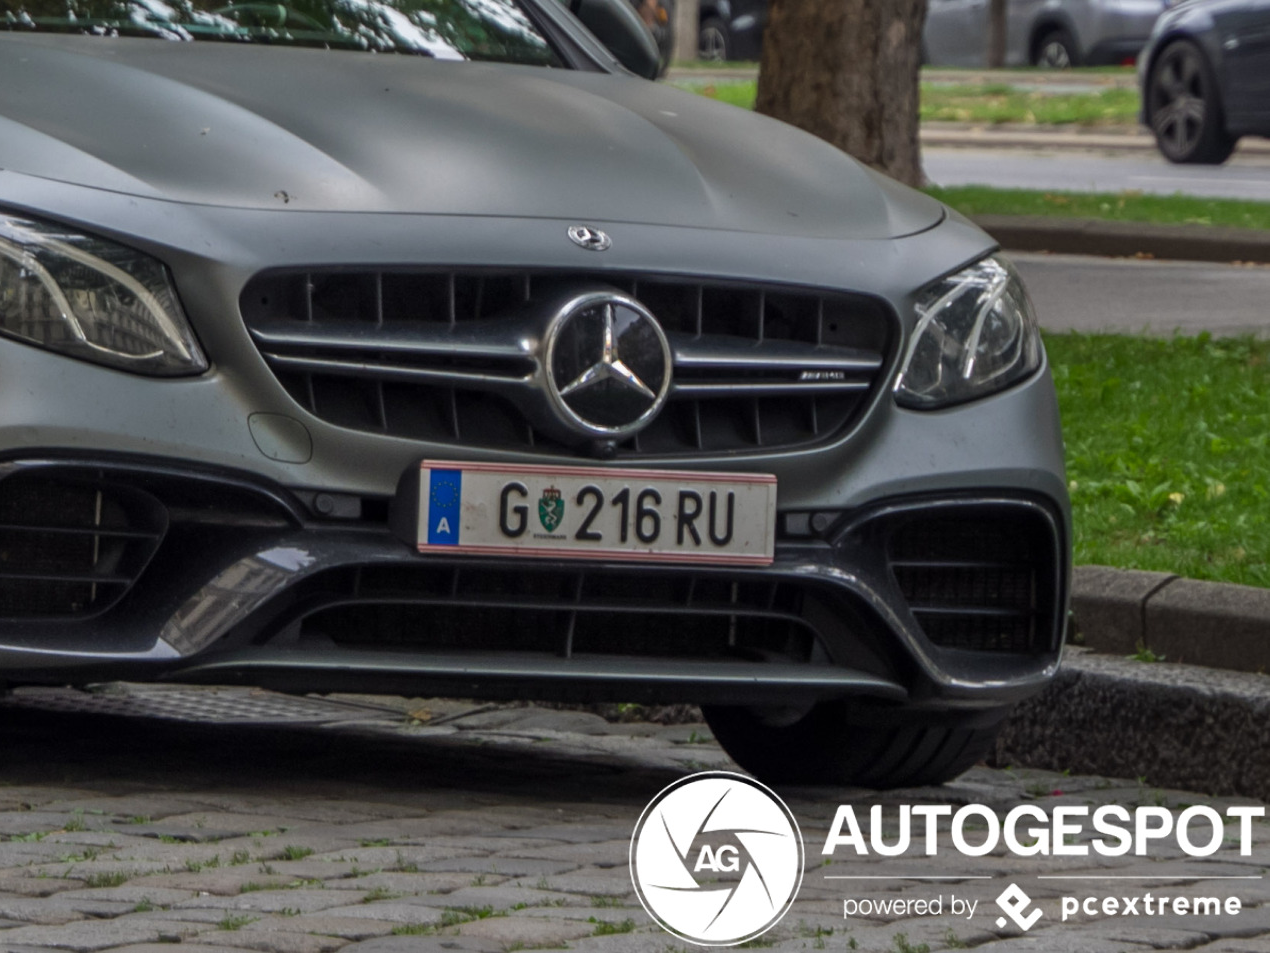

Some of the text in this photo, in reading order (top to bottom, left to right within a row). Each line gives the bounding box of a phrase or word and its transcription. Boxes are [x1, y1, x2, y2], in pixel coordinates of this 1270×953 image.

[436, 516, 451, 535] A
[499, 481, 735, 546] G 216 RU
